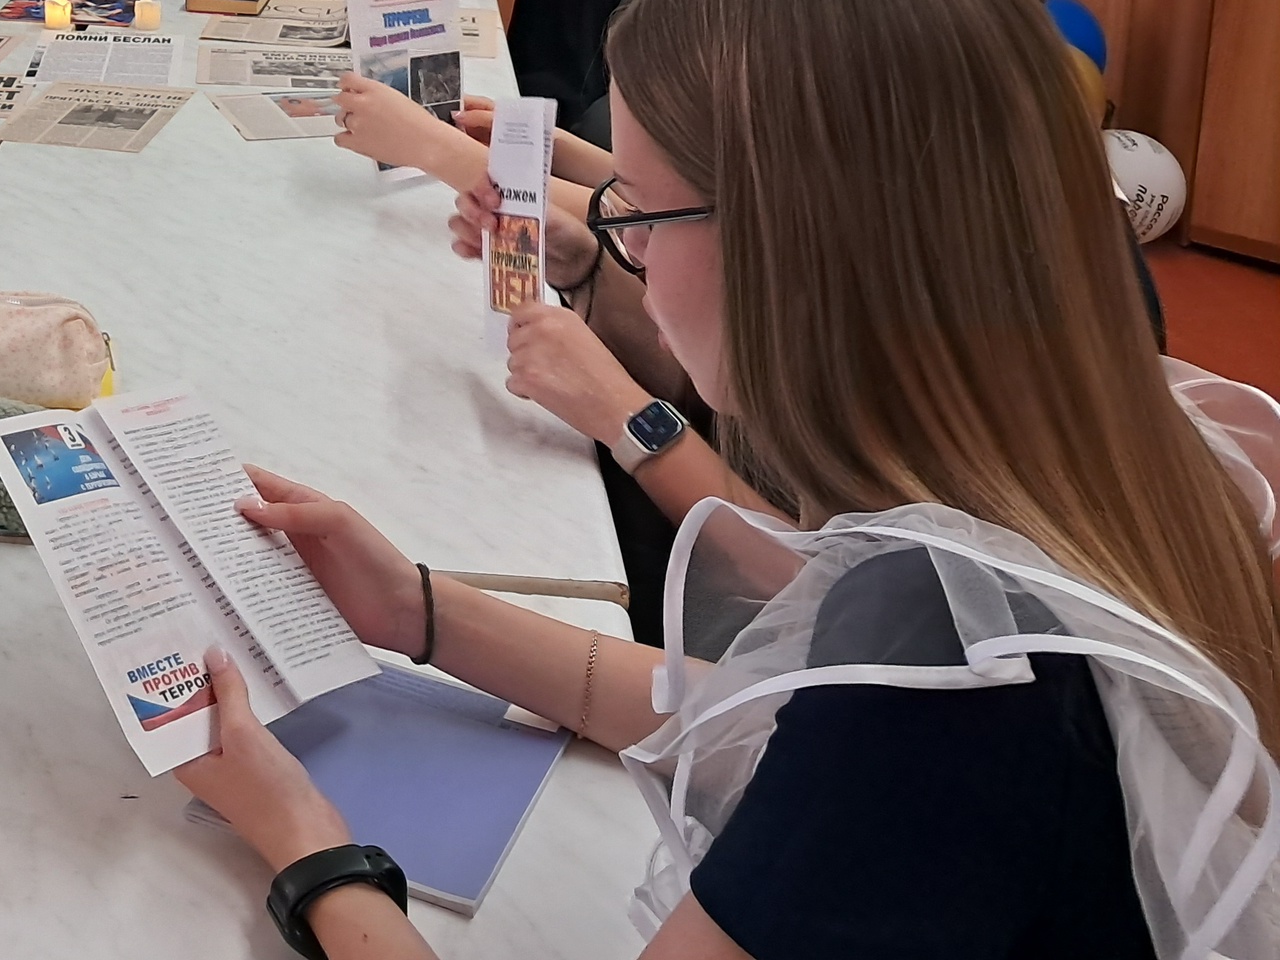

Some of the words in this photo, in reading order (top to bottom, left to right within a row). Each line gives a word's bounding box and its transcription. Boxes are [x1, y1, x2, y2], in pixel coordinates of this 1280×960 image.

[55, 33, 108, 43] ПОМНИ
[113, 35, 172, 45] БЕСЛАН
[63, 426, 77, 443] 3
[127, 652, 184, 684] ВМЕСТЕ
[142, 662, 200, 695] ПРОТИВ
[159, 673, 212, 703] ТЕРРОР
